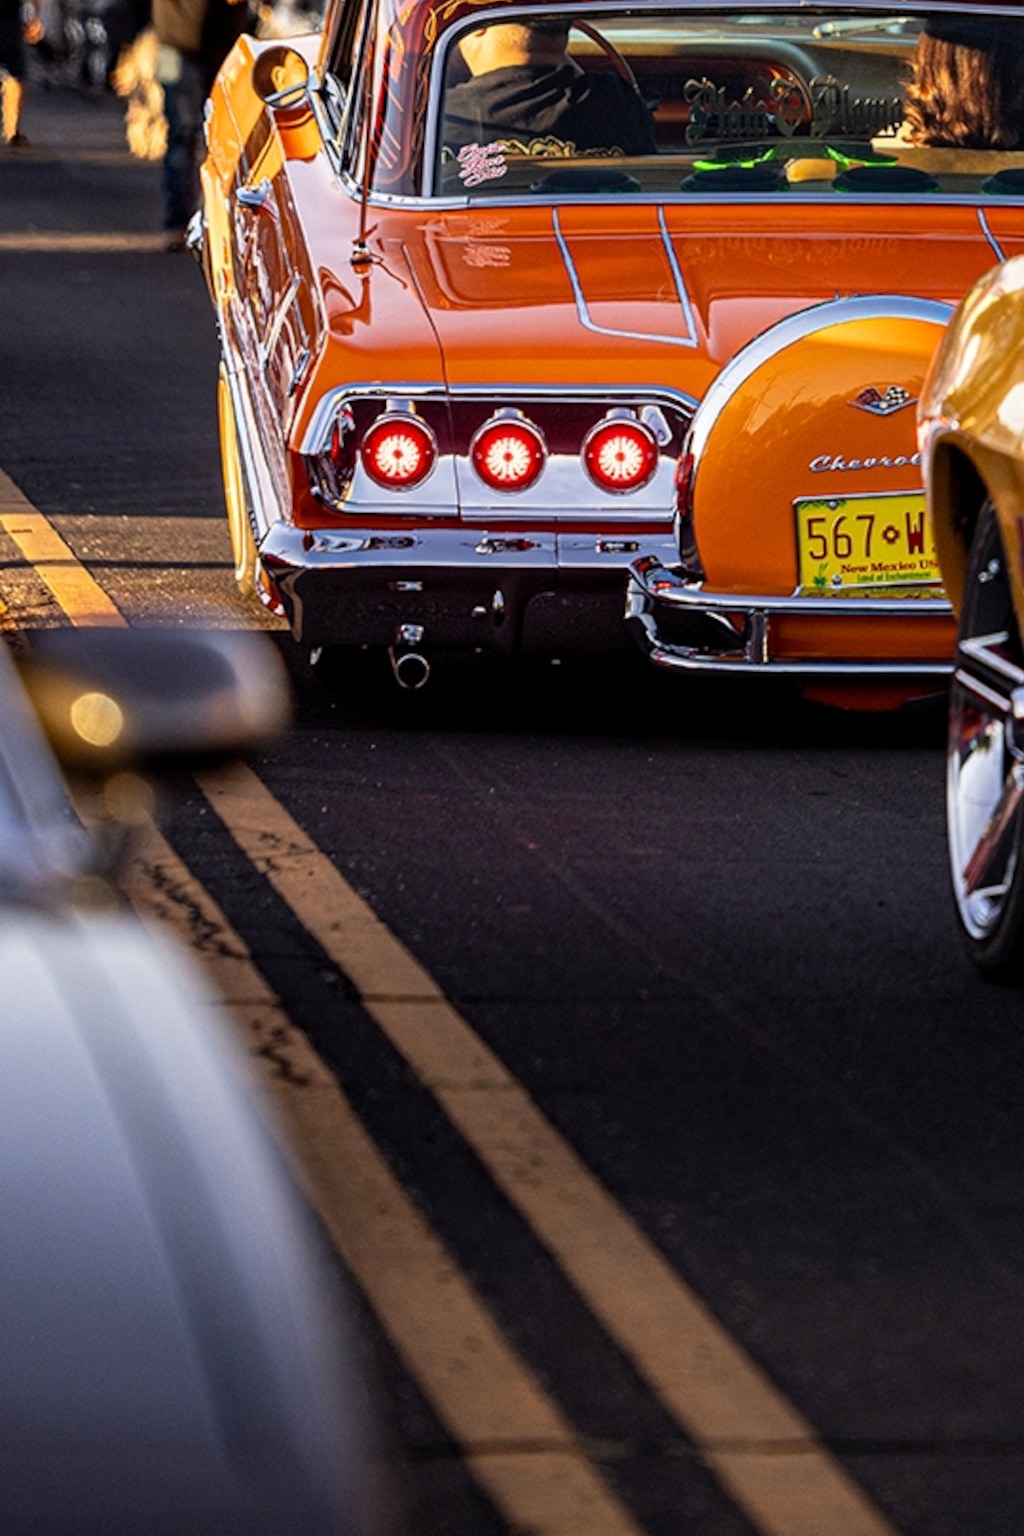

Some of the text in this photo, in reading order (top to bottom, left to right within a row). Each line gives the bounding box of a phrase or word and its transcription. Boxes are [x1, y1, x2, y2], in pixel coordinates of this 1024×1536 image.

[807, 515, 875, 559] 567
[841, 563, 869, 574] New
[871, 561, 916, 573] Mexico
